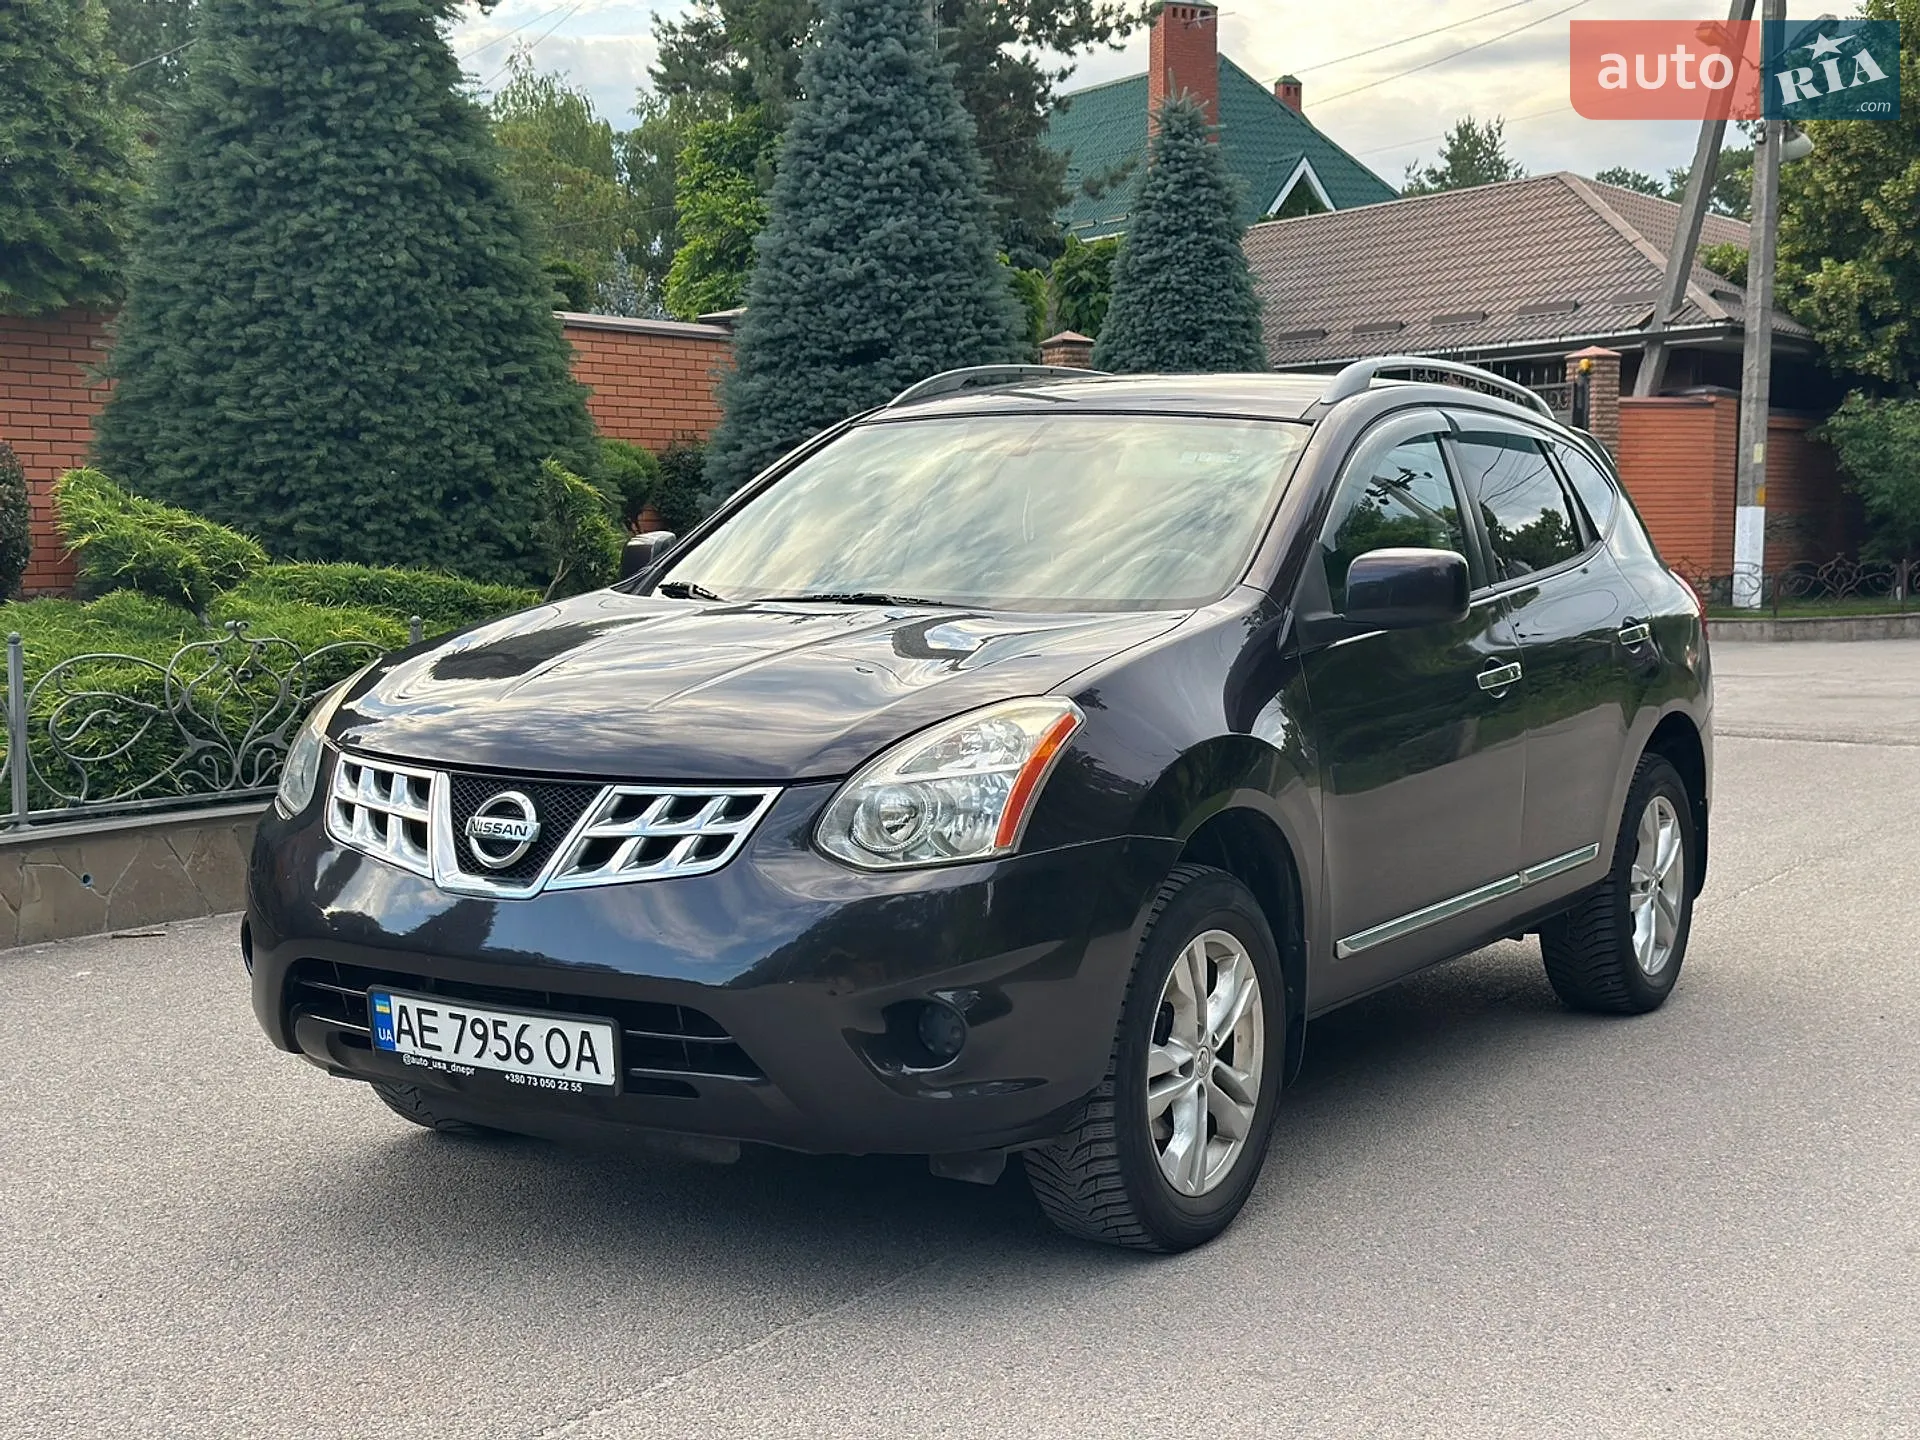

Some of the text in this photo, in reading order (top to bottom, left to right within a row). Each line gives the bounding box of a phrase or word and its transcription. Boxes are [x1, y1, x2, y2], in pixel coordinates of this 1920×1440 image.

[471, 820, 528, 837] NISSAN
[378, 1027, 394, 1042] UA
[396, 1004, 601, 1075] AE 7956 OA
[402, 1053, 475, 1076] @auto_usa_dnepr
[505, 1073, 583, 1092] +380 73 050 22 55
